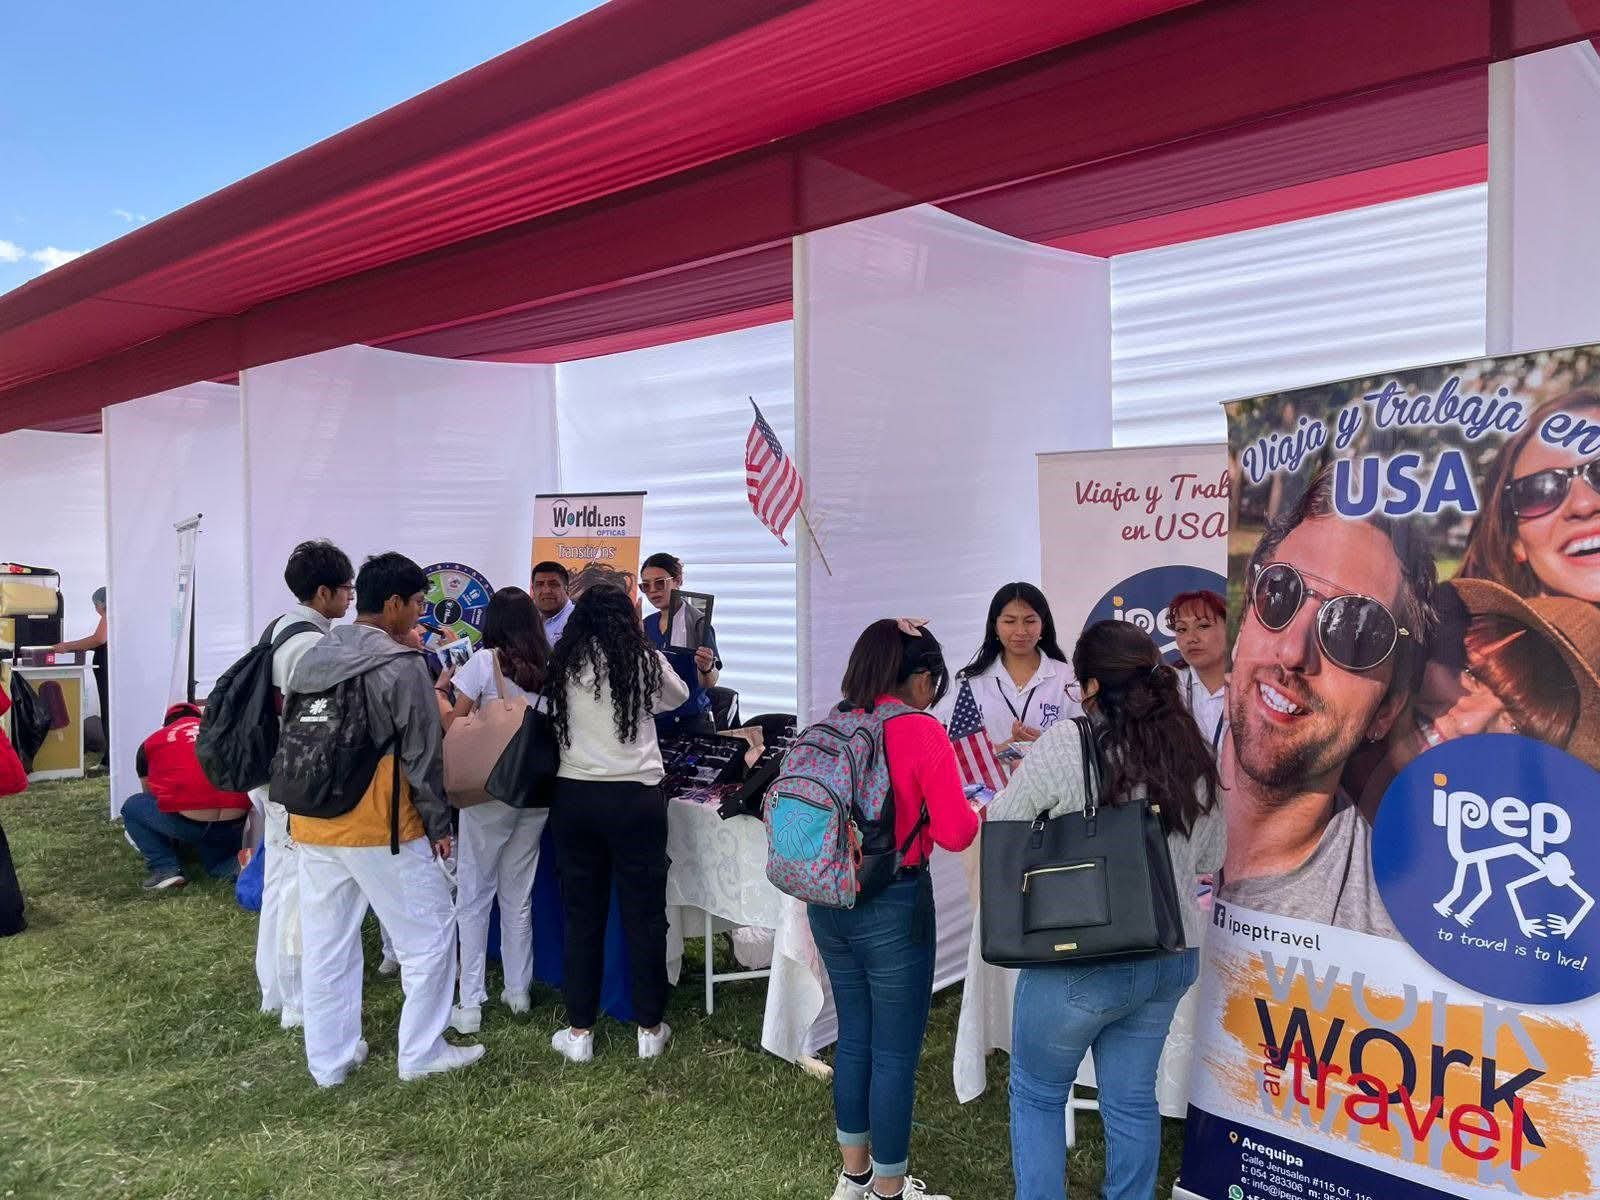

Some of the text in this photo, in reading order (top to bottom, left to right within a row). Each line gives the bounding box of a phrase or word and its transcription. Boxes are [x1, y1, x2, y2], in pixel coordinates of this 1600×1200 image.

[1242, 376, 1600, 484] Viaja y trabaja en
[1075, 480, 1140, 512] Viaja
[1145, 484, 1163, 514] y
[1335, 451, 1478, 517] USA
[596, 529, 626, 537] OPTICAS
[1121, 512, 1228, 541] en USA
[1433, 773, 1572, 855] ipep
[1228, 914, 1321, 951] ipeptravel
[1438, 927, 1588, 971] to travel is to live!
[1258, 1043, 1282, 1097] and
[1288, 1039, 1524, 1172] travel
[1242, 1137, 1304, 1167] Arequipa
[1240, 1176, 1250, 1185] e:
[1241, 1152, 1265, 1167] Calle
[1266, 1161, 1310, 1184] Jerusalen
[1312, 1177, 1336, 1193] #115
[1241, 1163, 1249, 1173] t:
[1250, 1166, 1267, 1180] 054
[1269, 1173, 1304, 1193] 283306
[1308, 1189, 1321, 1199] m:
